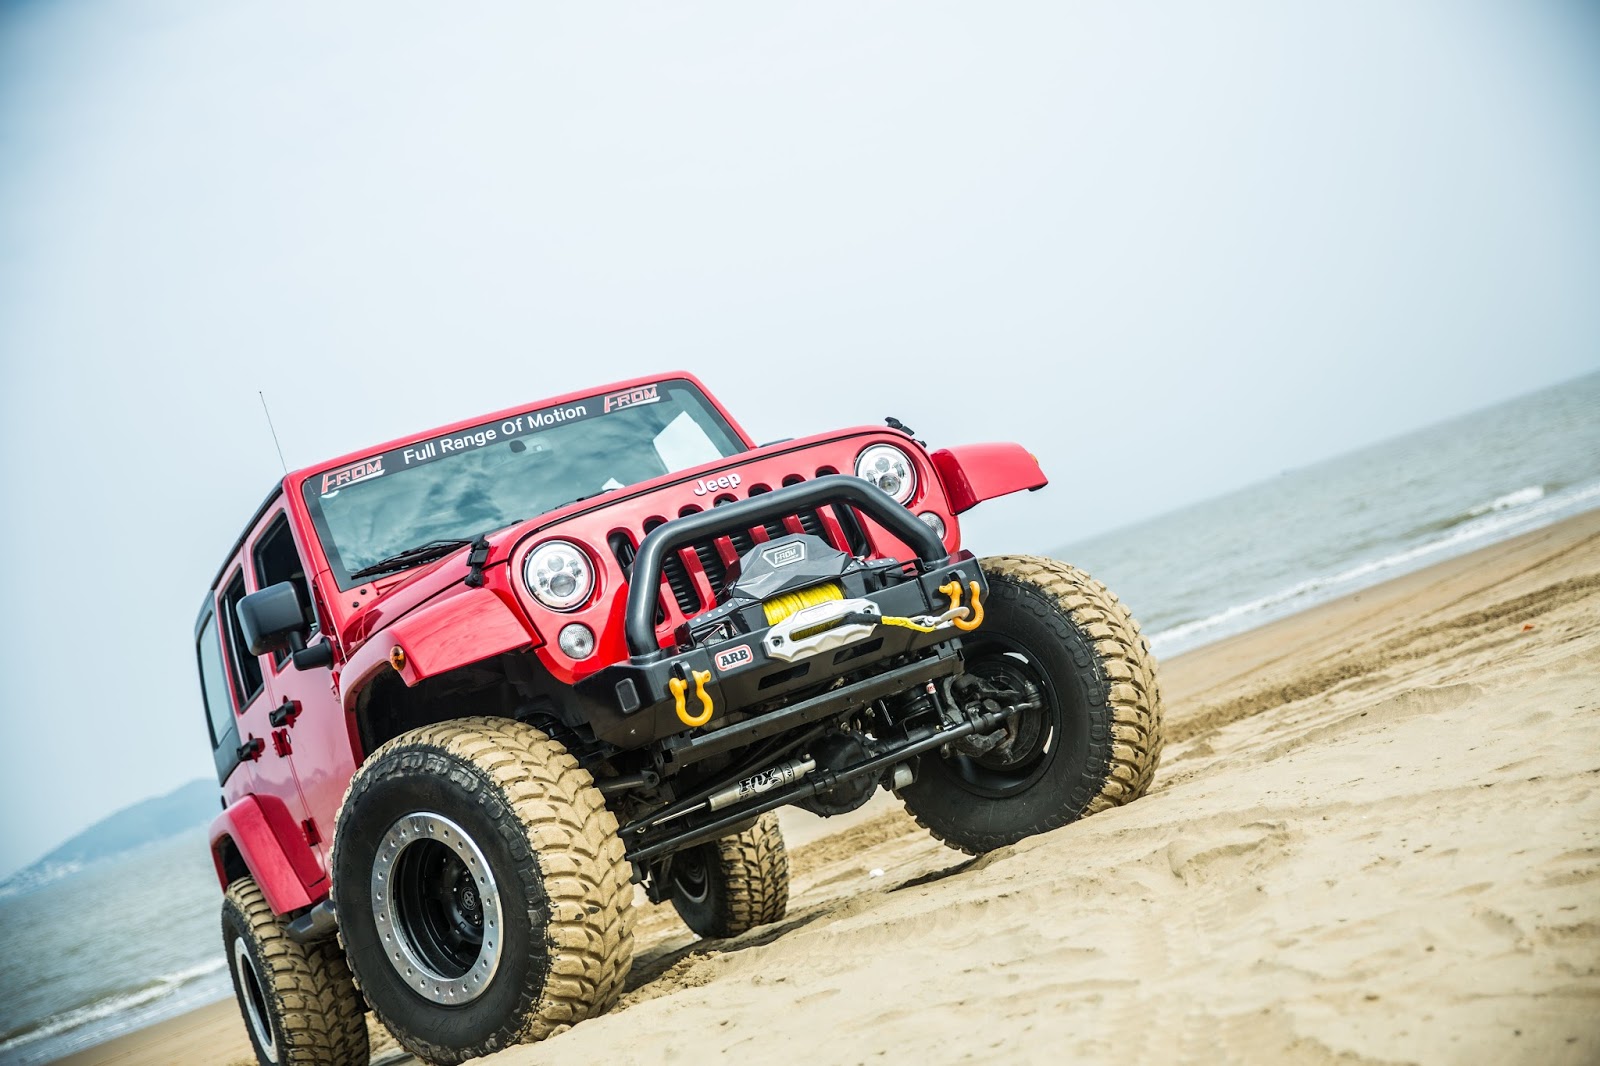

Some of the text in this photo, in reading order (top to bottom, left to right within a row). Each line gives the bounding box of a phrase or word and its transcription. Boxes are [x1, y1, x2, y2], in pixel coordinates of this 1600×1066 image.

[604, 384, 658, 413] FROM
[403, 404, 587, 465] Full Range Of Motion
[321, 456, 383, 494] FROM
[694, 473, 741, 496] Jeep
[720, 650, 748, 667] ARB
[738, 768, 778, 795] FOX
